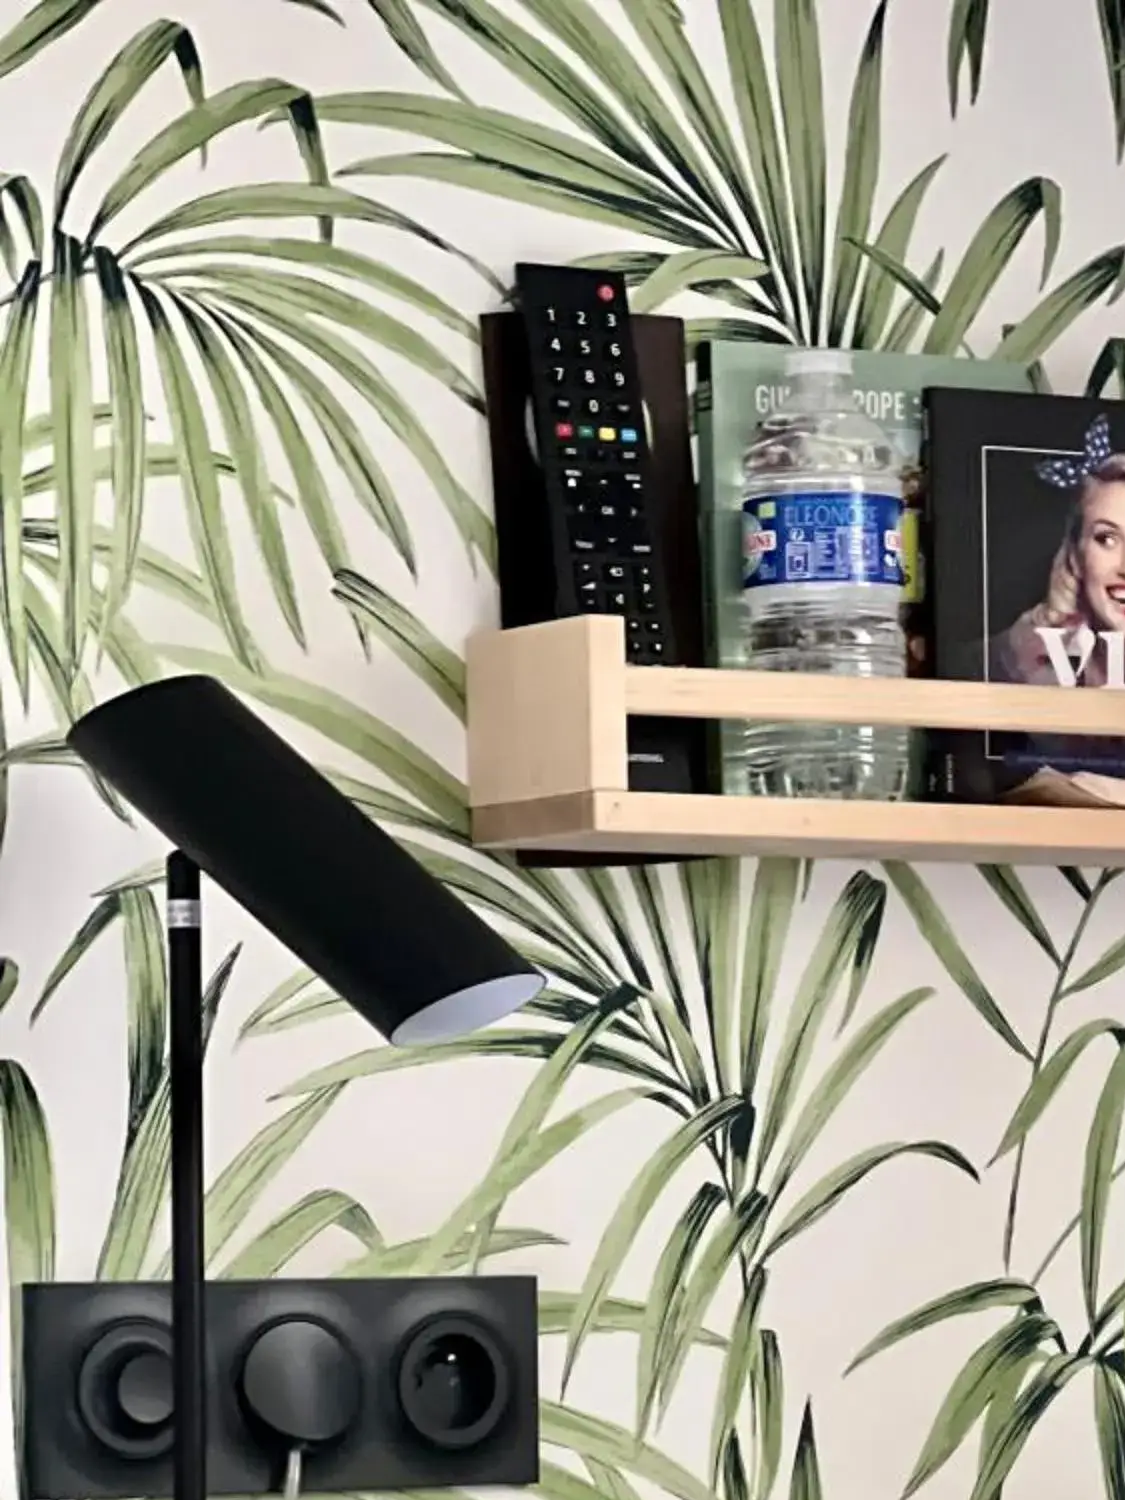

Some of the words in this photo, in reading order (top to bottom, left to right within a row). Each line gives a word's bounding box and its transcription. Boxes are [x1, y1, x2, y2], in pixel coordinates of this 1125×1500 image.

[547, 308, 555, 321] 1
[576, 311, 587, 325] 2
[607, 313, 617, 327] 3
[551, 338, 561, 351] 4
[580, 340, 591, 354] 5
[610, 343, 621, 357] 6
[553, 367, 564, 381] 7
[584, 369, 596, 384] 8
[614, 372, 625, 386] 9
[588, 399, 599, 413] 0
